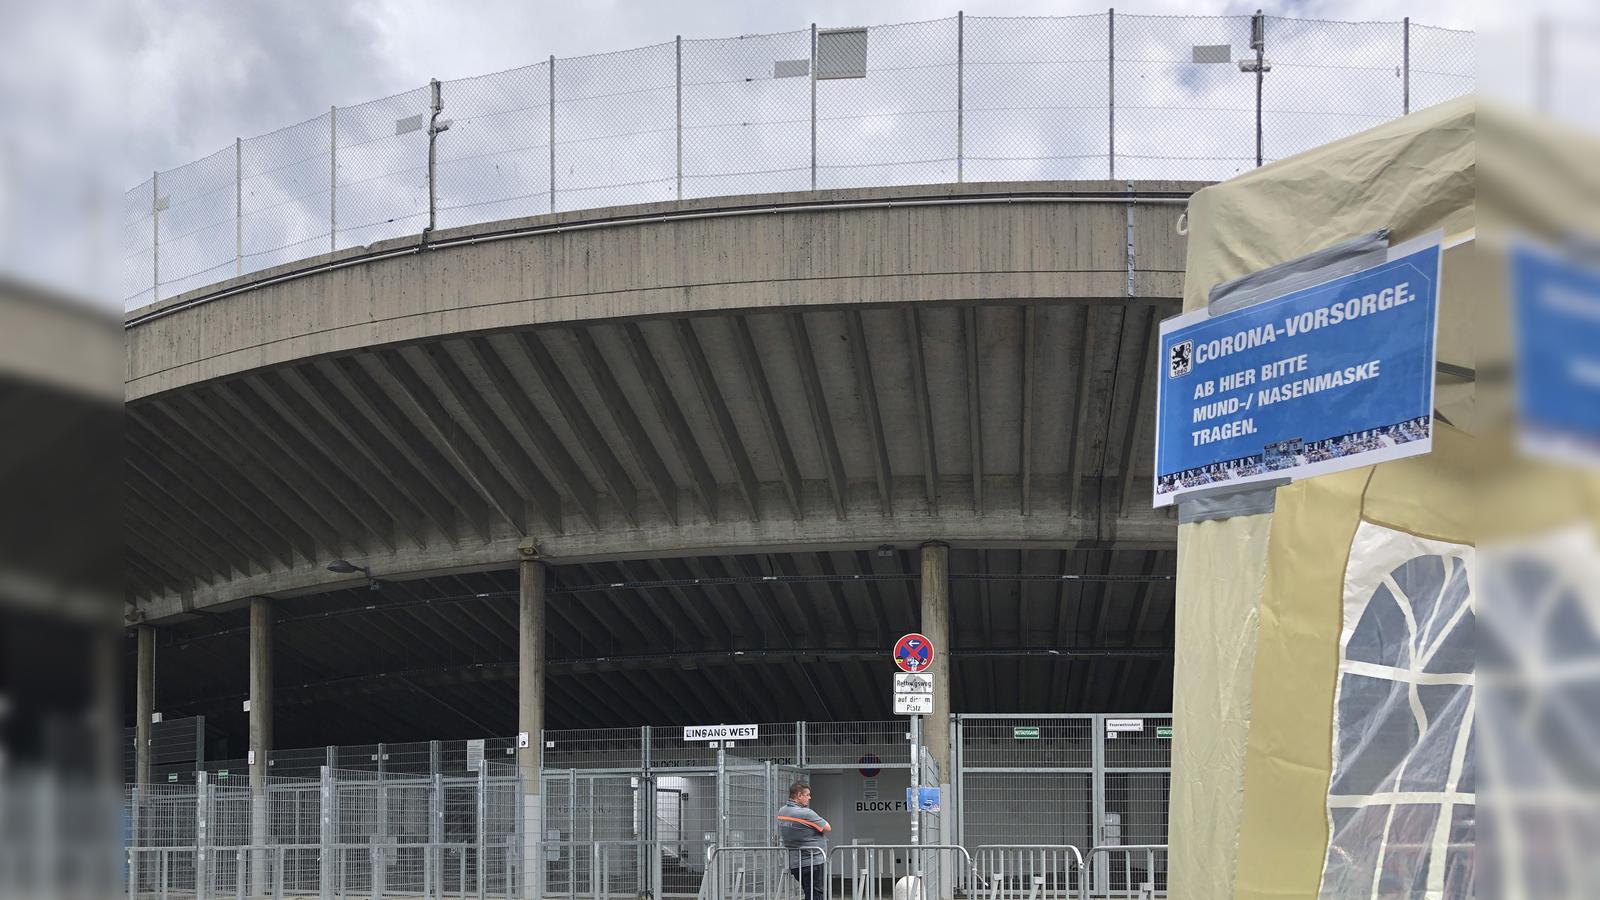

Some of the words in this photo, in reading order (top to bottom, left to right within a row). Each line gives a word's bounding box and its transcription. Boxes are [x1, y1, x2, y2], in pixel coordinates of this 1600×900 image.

[1195, 282, 1416, 364] CORONA-VORSORGE.
[1193, 394, 1253, 423] MUND-/
[1258, 360, 1381, 407] NASENMASKE
[1194, 380, 1215, 400] AB
[1219, 371, 1256, 392] HIER
[1261, 354, 1308, 382] BITTE
[1192, 418, 1258, 447] TRAGEN.
[729, 727, 757, 737] WEST
[856, 802, 892, 811] BLOCK
